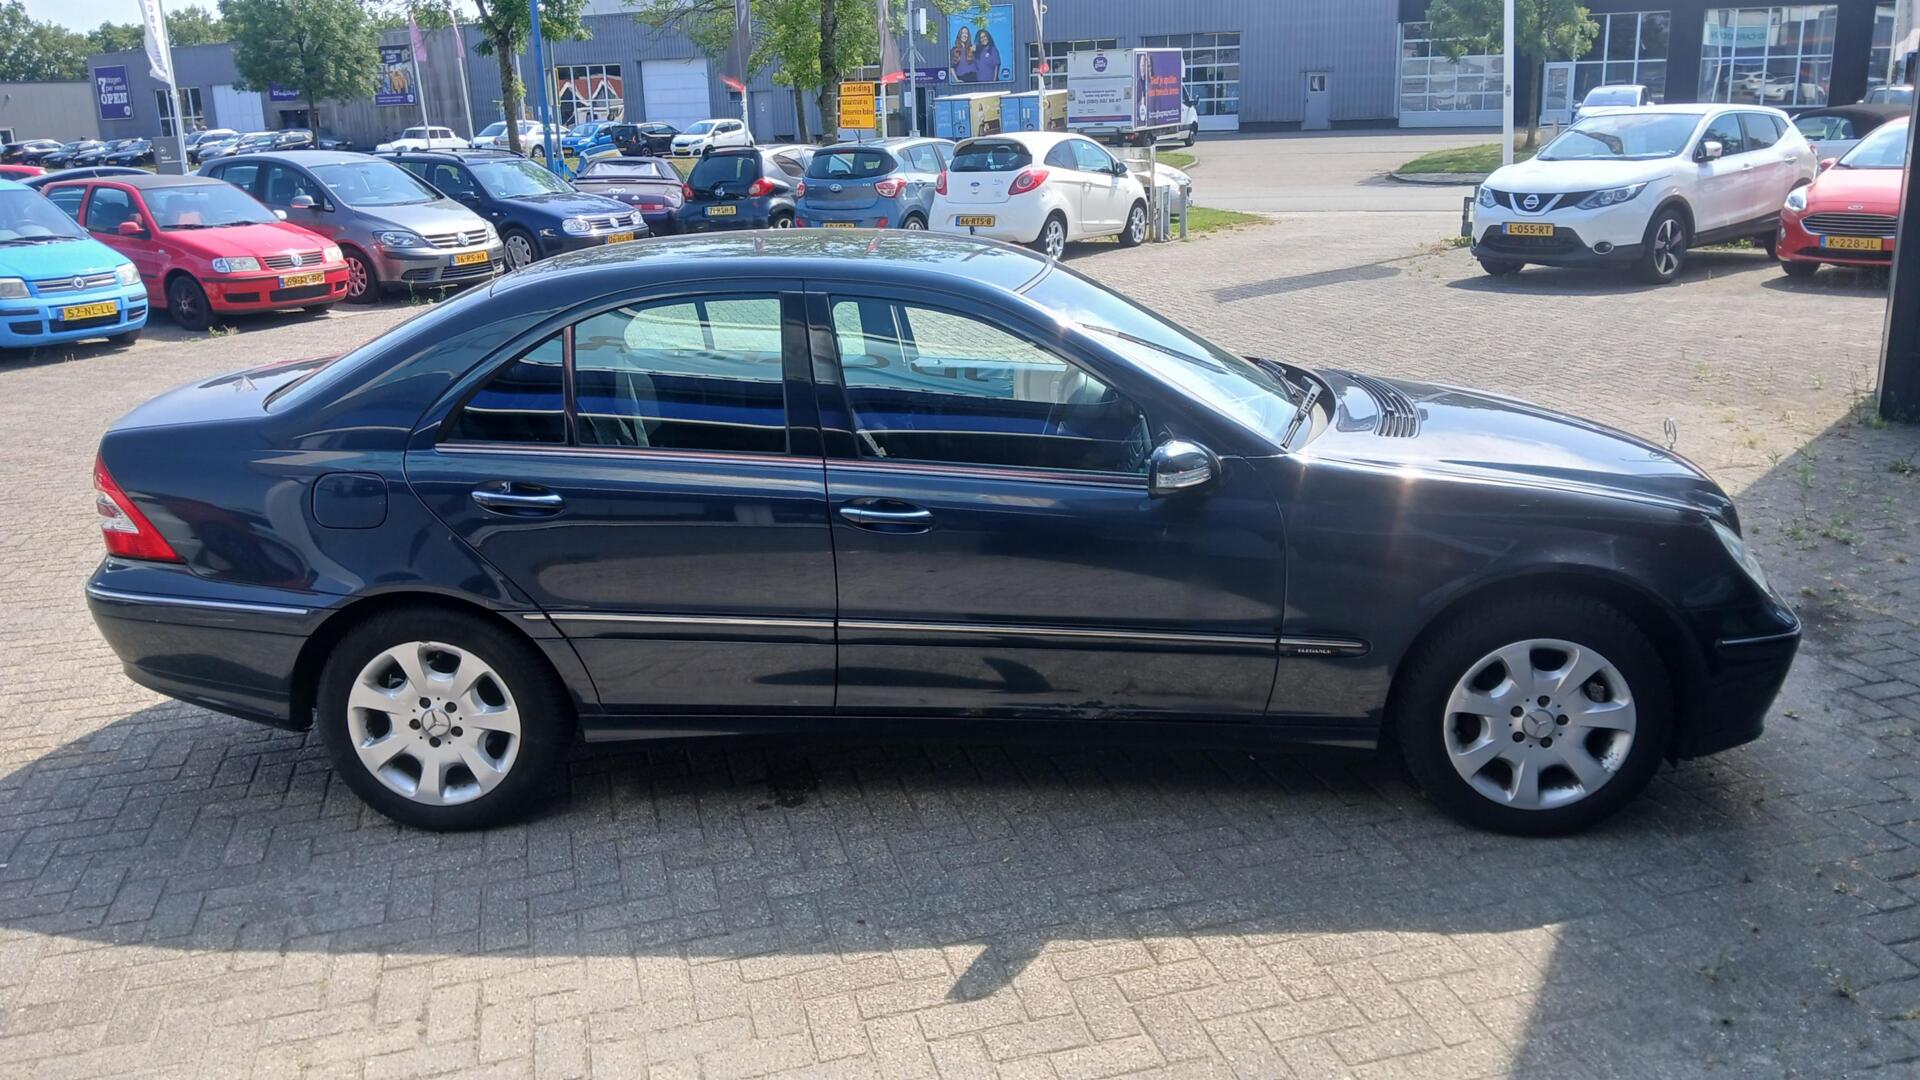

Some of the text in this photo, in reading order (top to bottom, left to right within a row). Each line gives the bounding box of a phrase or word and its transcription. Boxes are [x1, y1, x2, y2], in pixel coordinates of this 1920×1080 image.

[98, 77, 106, 92] 7
[101, 93, 127, 104] OPEN
[961, 217, 992, 225] 66-RTS-8
[1509, 225, 1552, 235] L-055-RT
[1829, 237, 1877, 249] K-228-JL
